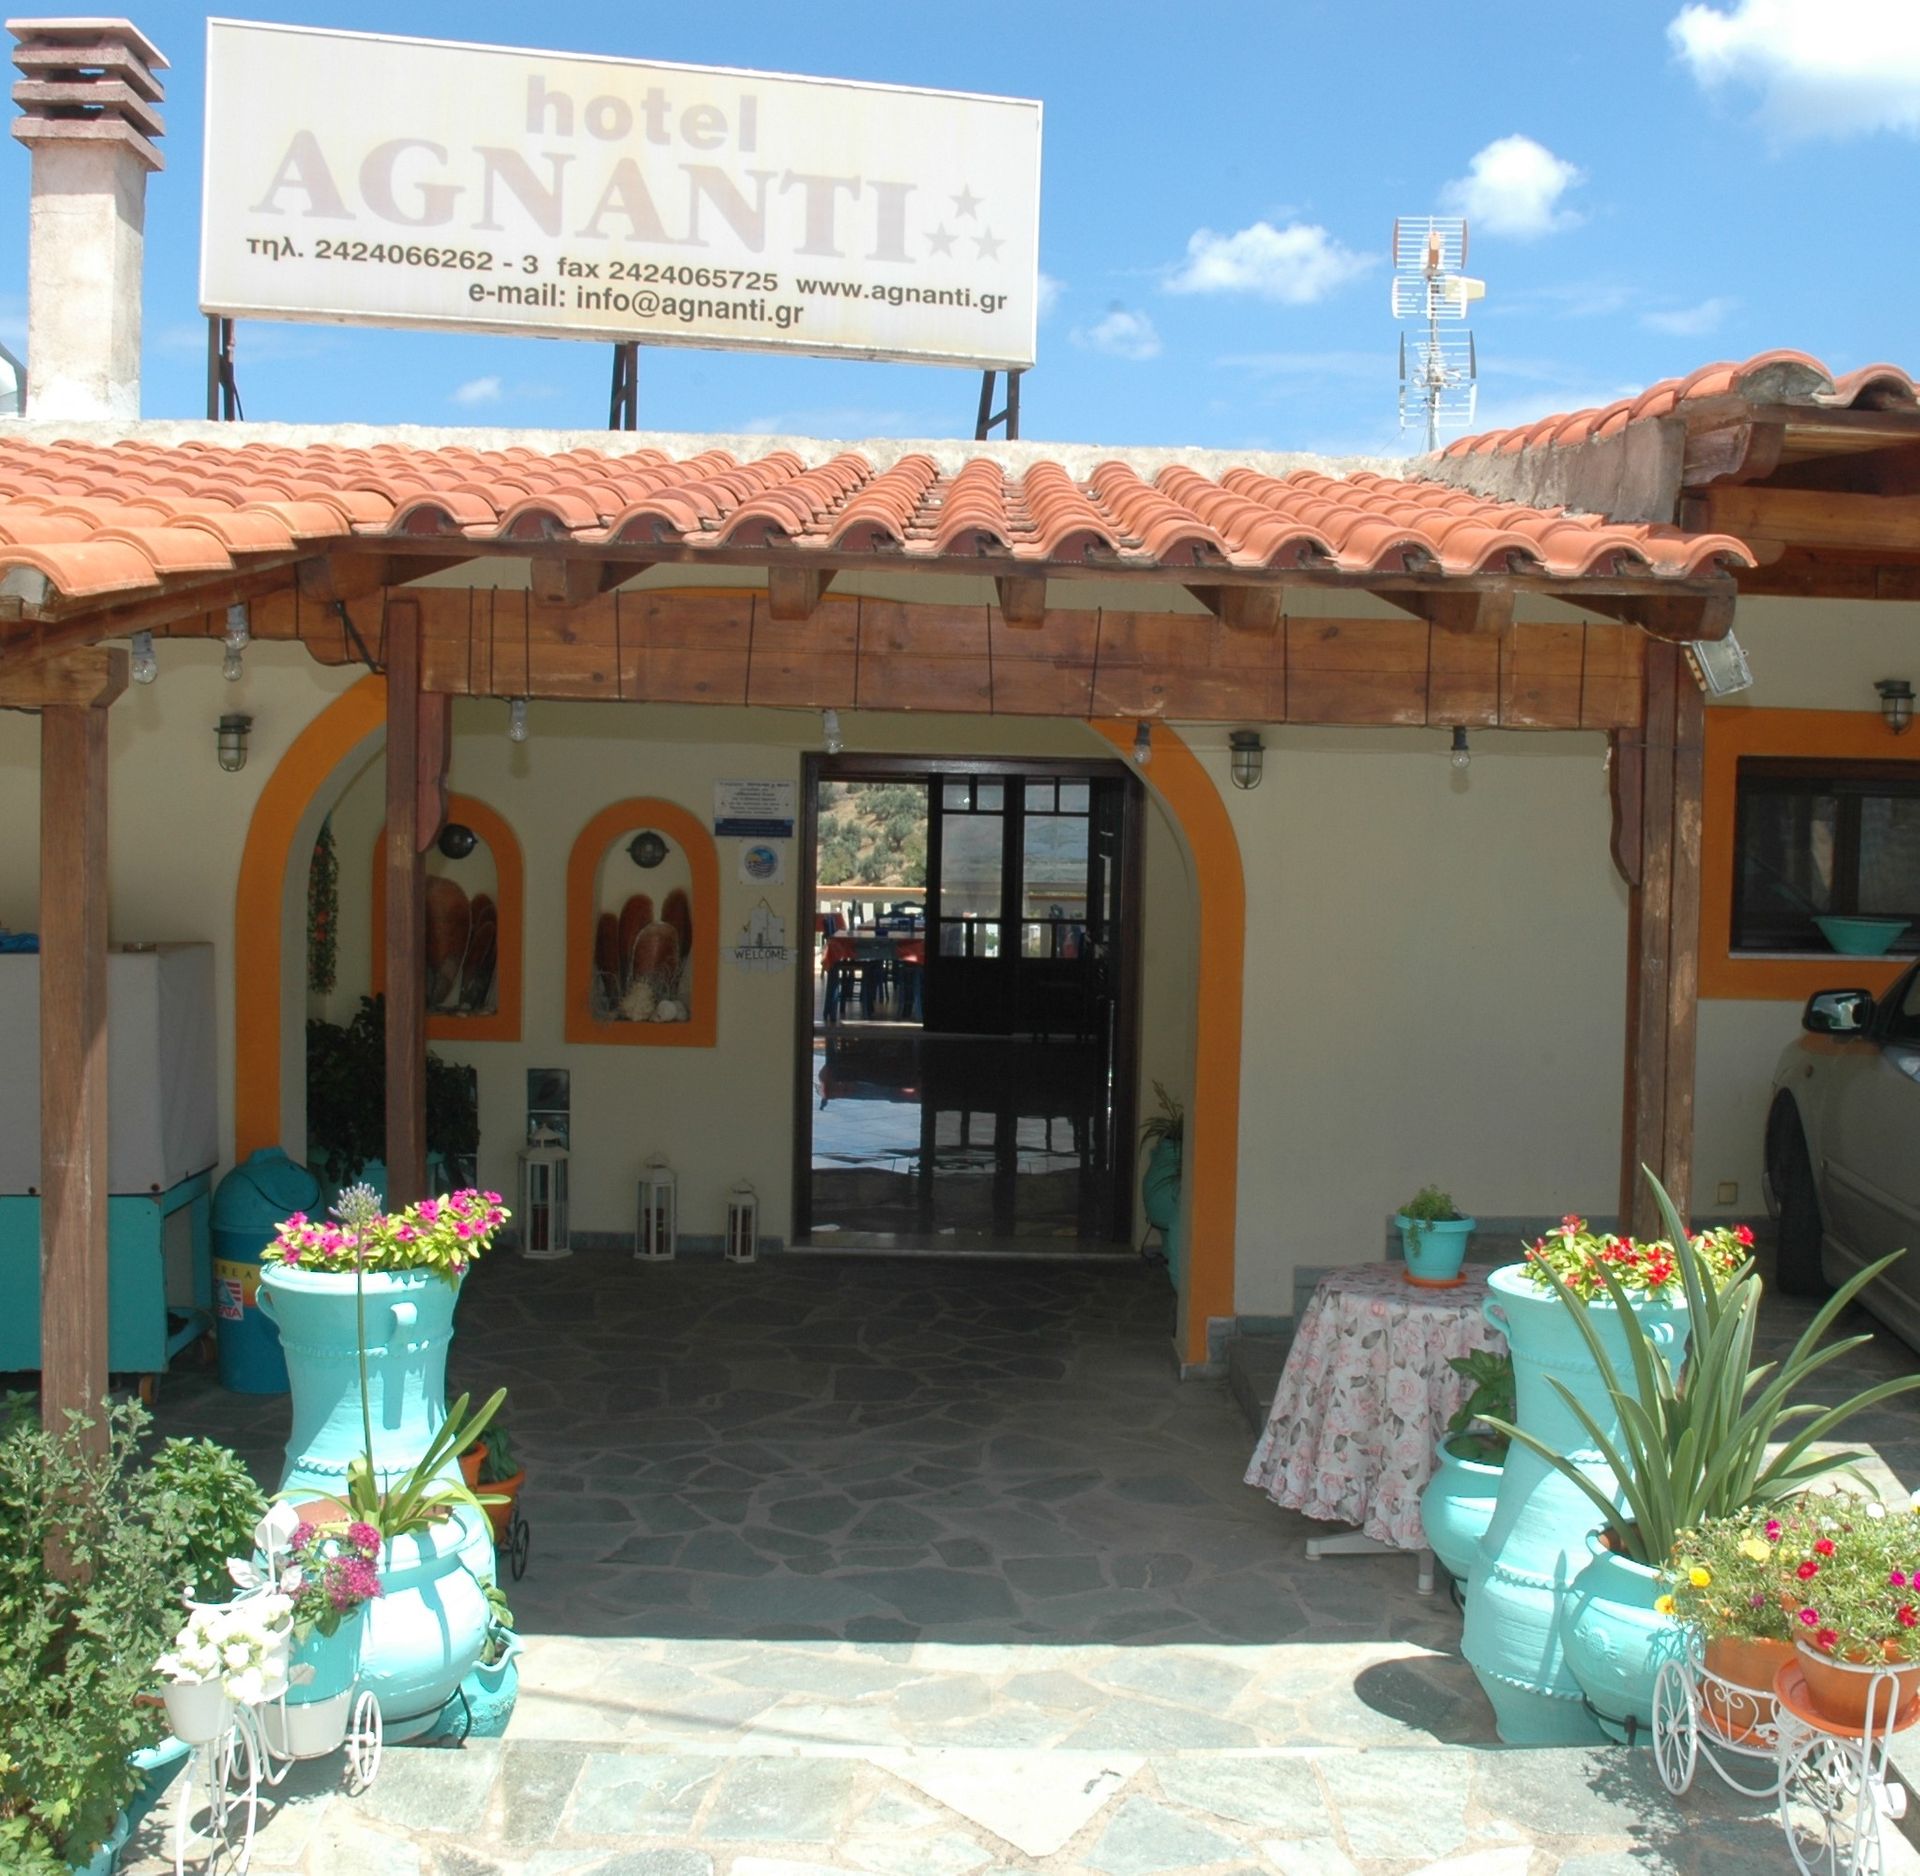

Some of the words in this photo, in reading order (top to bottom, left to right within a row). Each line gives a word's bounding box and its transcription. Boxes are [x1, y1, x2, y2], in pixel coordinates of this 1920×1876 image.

[526, 75, 758, 153] hotel
[248, 130, 918, 265] AGNANTI
[246, 236, 304, 262] τηλ.
[315, 239, 494, 272] 2424066262
[522, 255, 539, 274] 3
[557, 256, 600, 279] fax
[608, 261, 779, 292] 2424065725
[796, 276, 1008, 314] www.agnanti.gr
[468, 283, 567, 308] e-mail:
[577, 285, 804, 329] info@agnanti.gr
[735, 950, 788, 961] WELCOME
